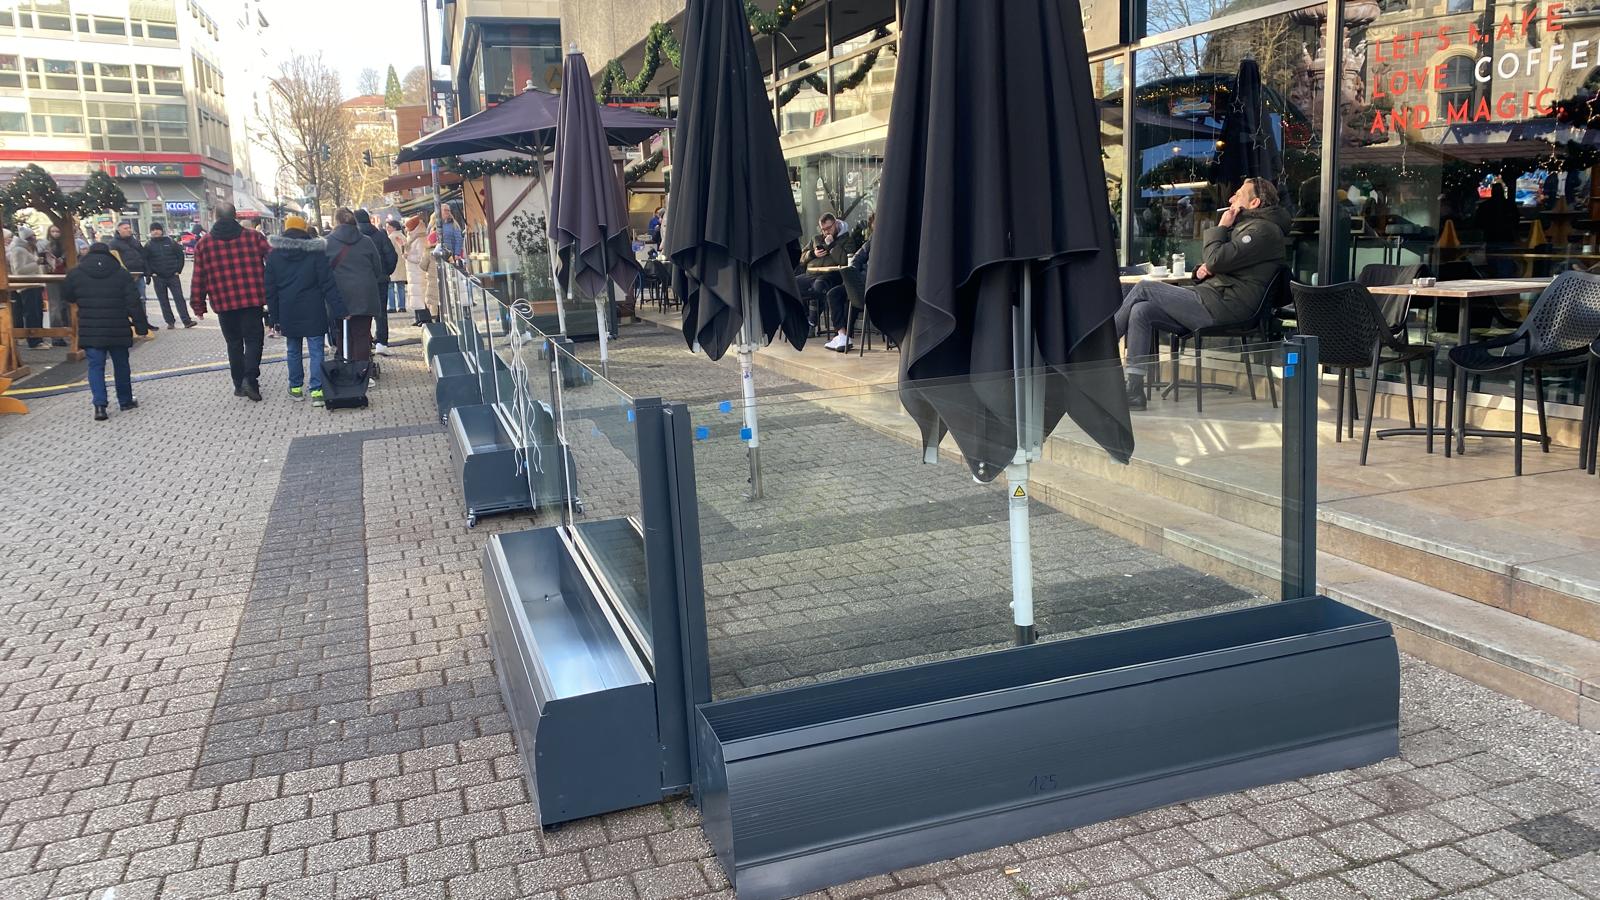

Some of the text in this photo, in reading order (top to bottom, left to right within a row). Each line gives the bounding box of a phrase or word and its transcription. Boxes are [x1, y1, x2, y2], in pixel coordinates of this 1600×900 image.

[1375, 26, 1453, 64] LET'S
[1373, 39, 1600, 99] LOVE COFFE
[1370, 87, 1566, 134] AND MAGIC.
[166, 202, 196, 210] KIOSK
